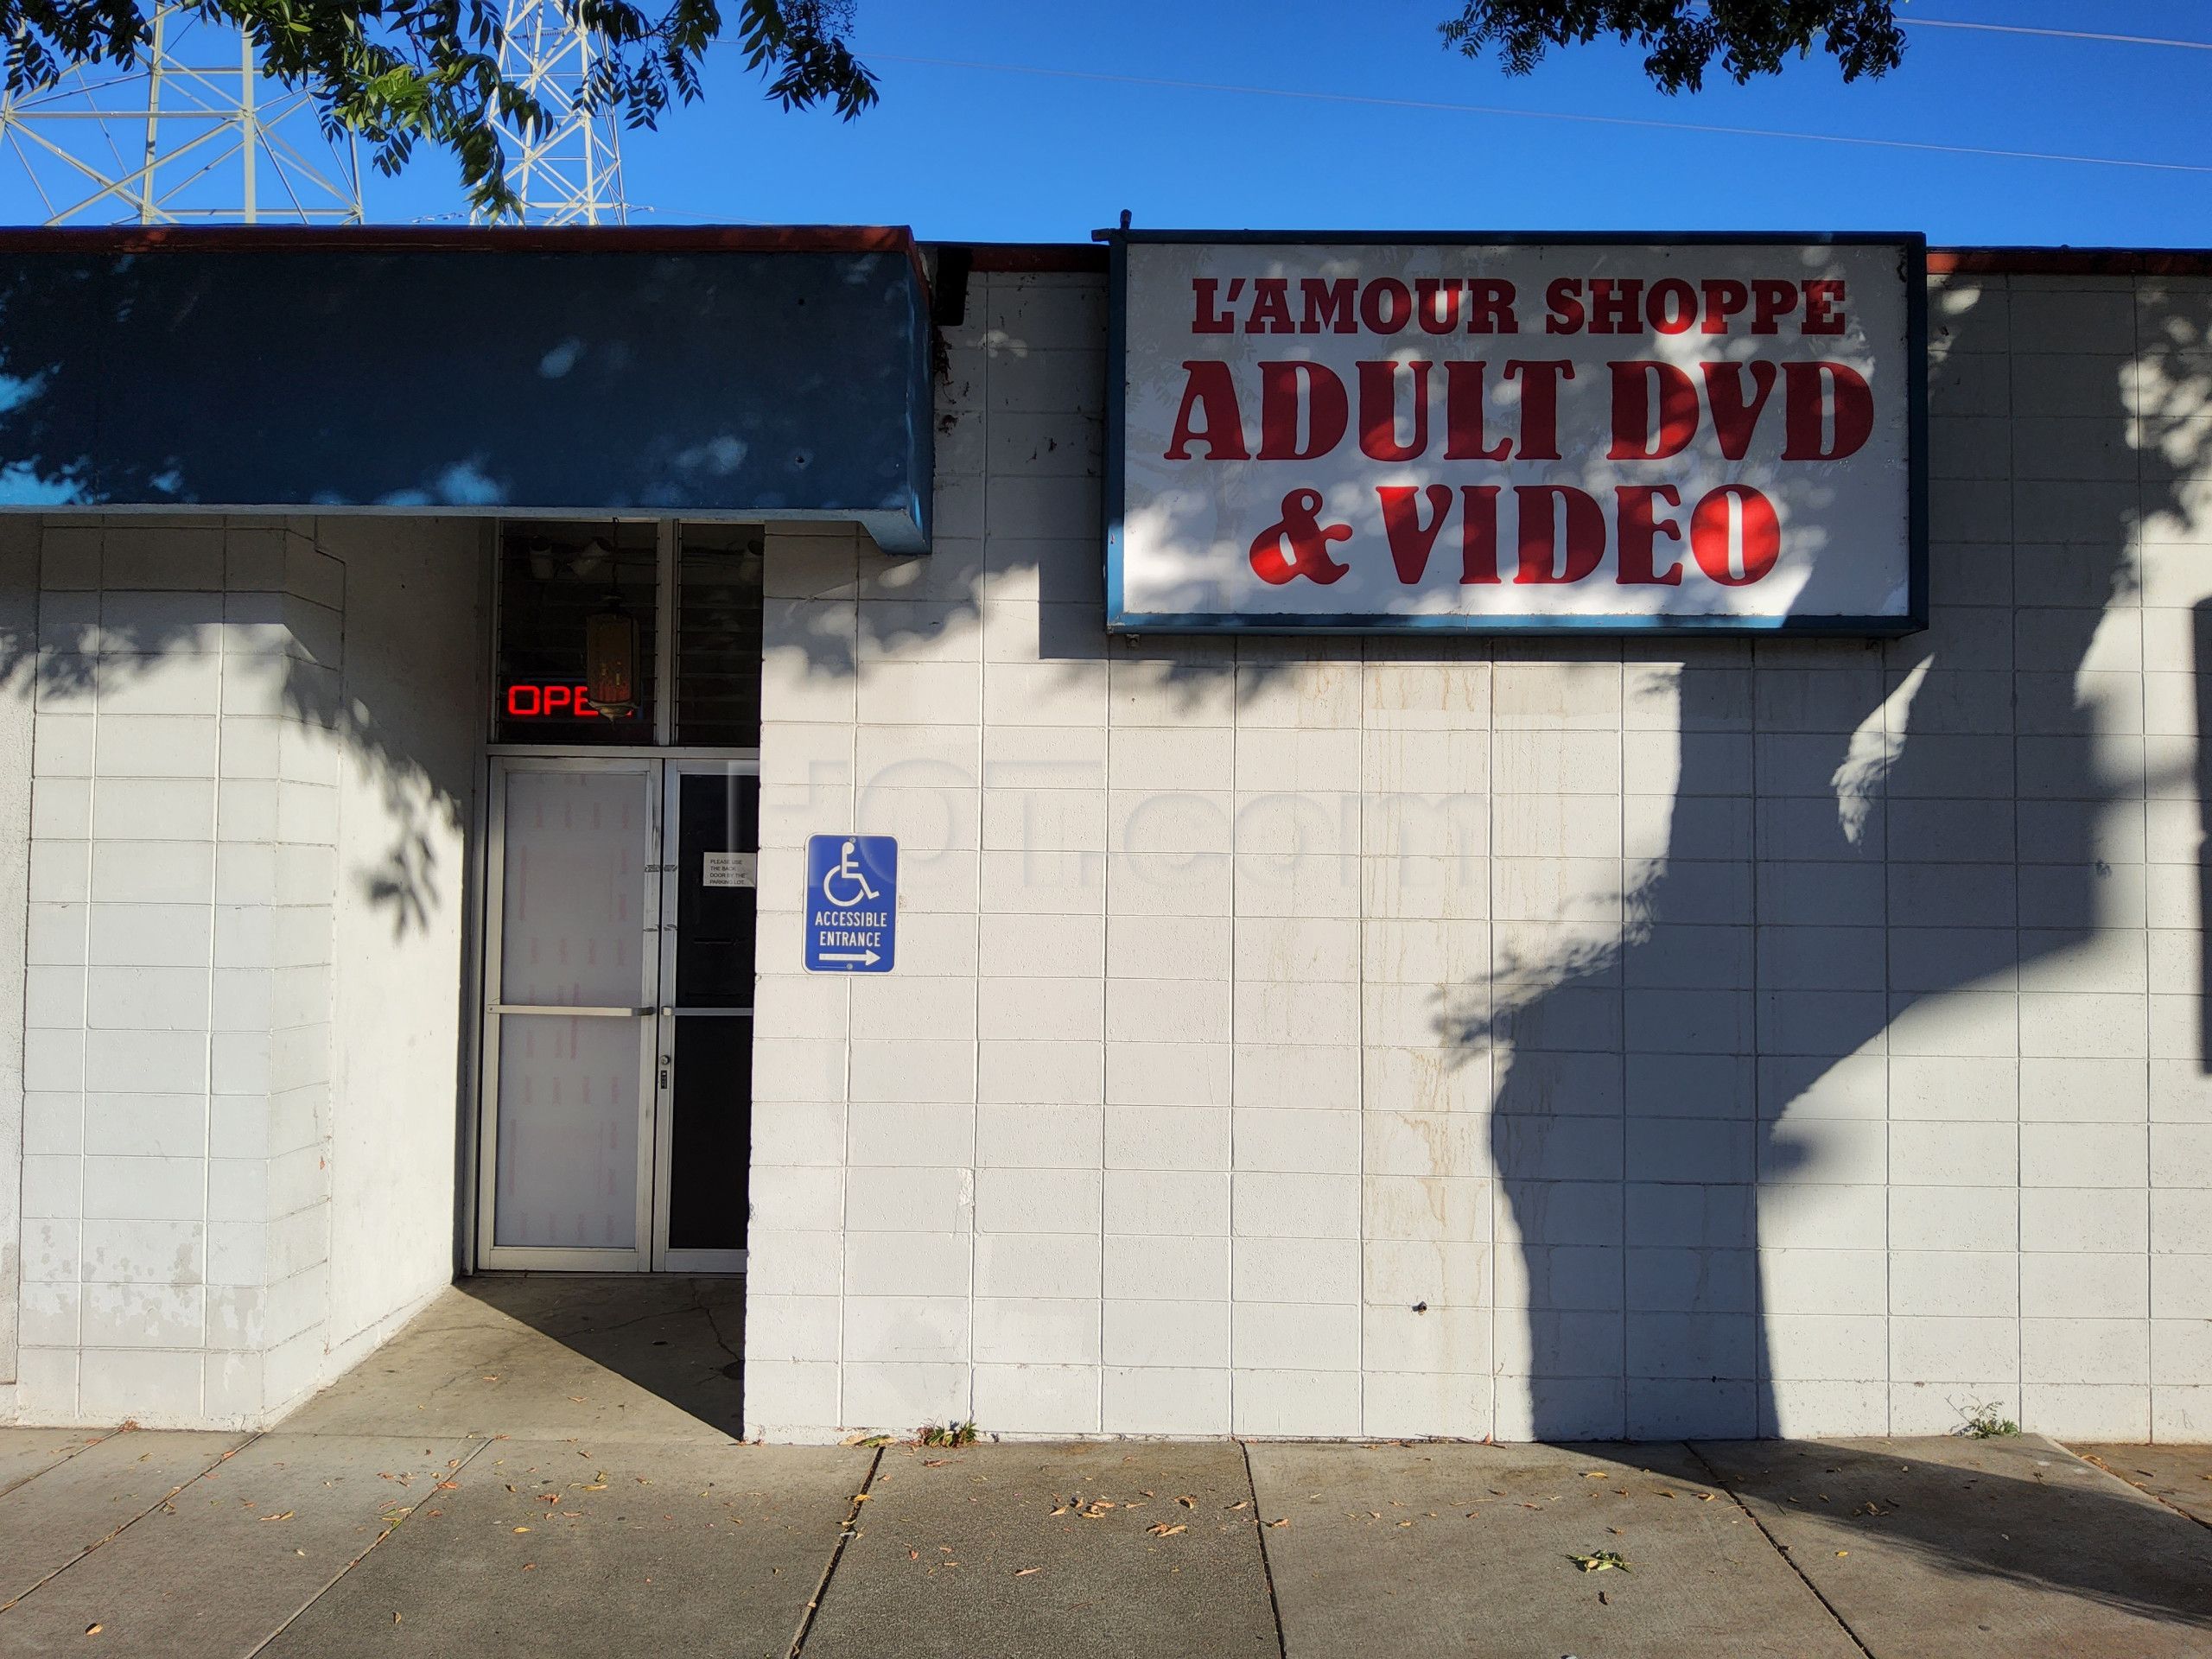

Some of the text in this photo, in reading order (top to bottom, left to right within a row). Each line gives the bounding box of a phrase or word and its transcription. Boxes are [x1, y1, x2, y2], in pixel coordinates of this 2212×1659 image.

[1192, 278, 1845, 335] L'AMOUR SHOPPE
[1164, 359, 1873, 462] ADULT DVD
[1249, 484, 1780, 587] & VIDEO
[508, 685, 633, 715] OPE
[815, 911, 887, 927] ACCESSIBLE
[819, 931, 881, 947] ENTRANCE
